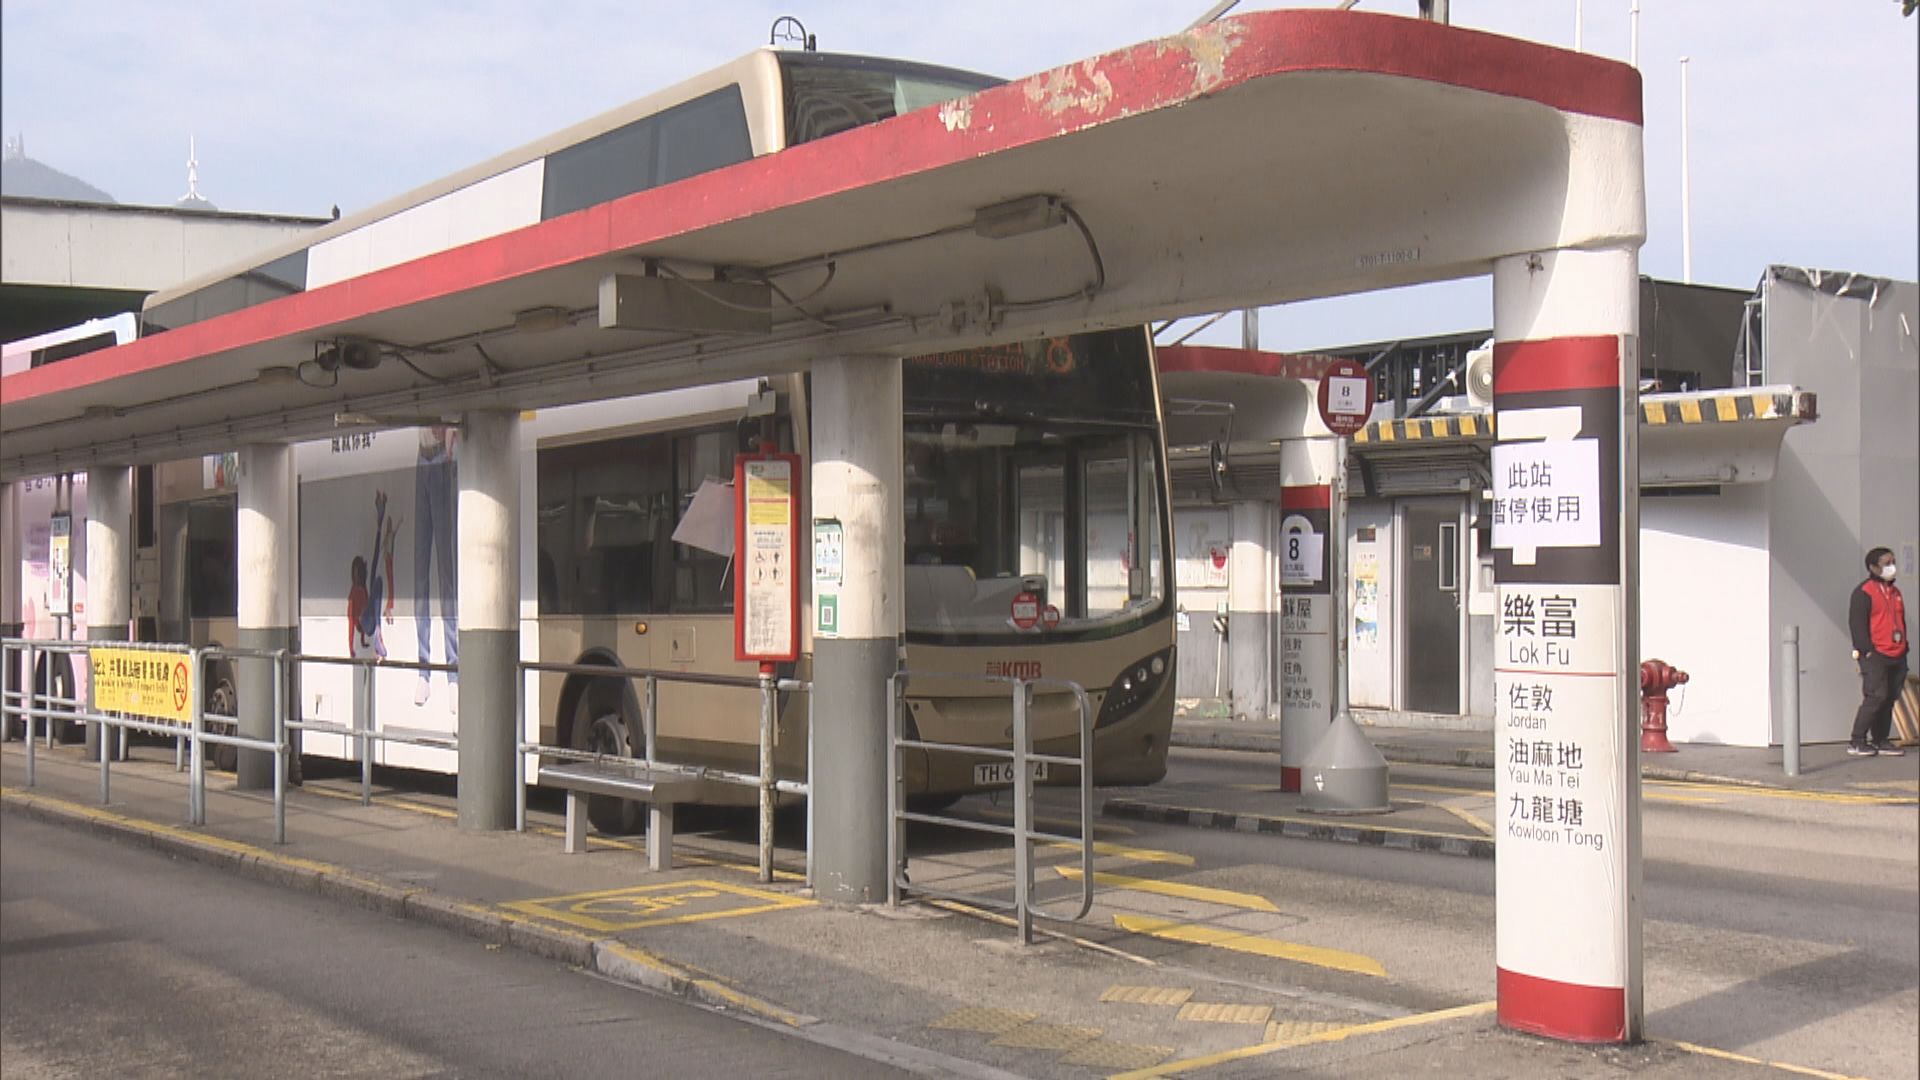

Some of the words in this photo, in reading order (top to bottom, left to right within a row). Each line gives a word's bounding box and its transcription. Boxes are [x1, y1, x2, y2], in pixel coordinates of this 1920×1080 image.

[1342, 386, 1350, 397] 8
[1508, 461, 1552, 489] 此站
[1494, 496, 1580, 525] 暫停使用
[1289, 538, 1299, 560] 8
[1504, 594, 1577, 639] 樂富
[1509, 640, 1539, 664] Lok
[1546, 642, 1569, 665] Fu
[1509, 682, 1552, 712] 佐敦
[1507, 713, 1547, 730] Jordan
[1509, 738, 1583, 769] 油麻地
[980, 764, 999, 781] TH
[1004, 761, 1043, 780] 64
[1508, 766, 1529, 783] Yau
[1534, 769, 1553, 786] Ma
[1558, 771, 1580, 788] Tei
[1510, 792, 1583, 826] 九龍塘
[1508, 820, 1559, 843] Kowloon
[1564, 828, 1603, 851] Tong
